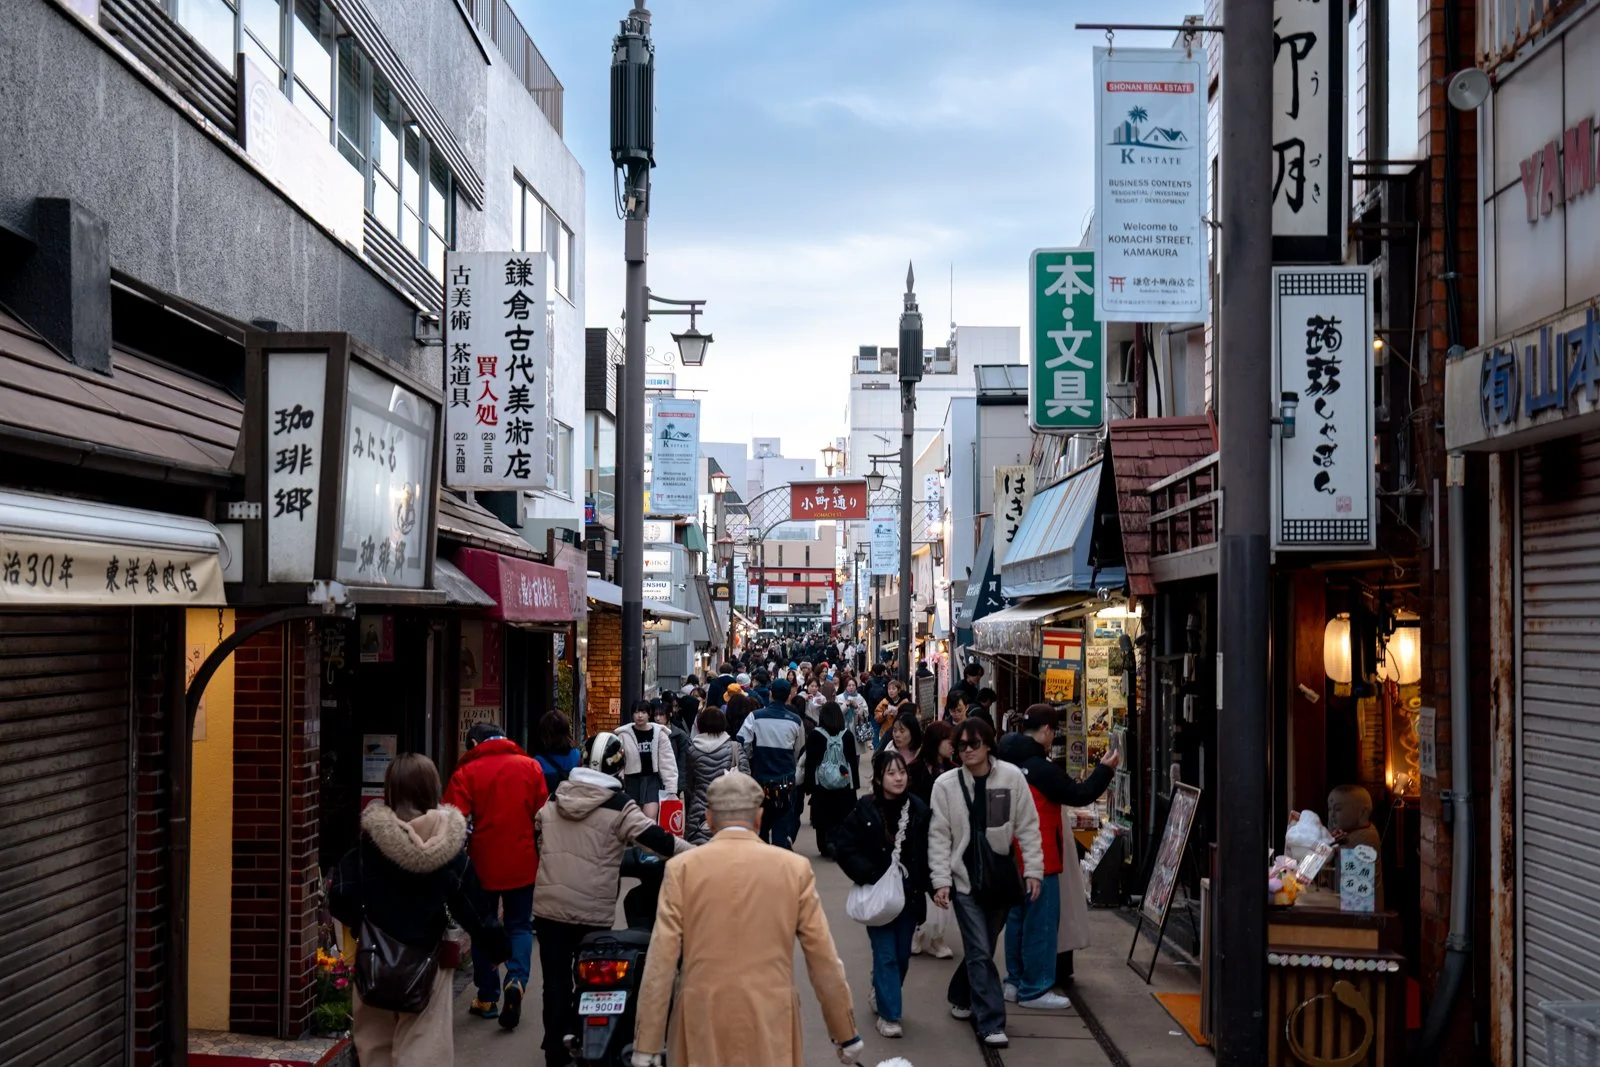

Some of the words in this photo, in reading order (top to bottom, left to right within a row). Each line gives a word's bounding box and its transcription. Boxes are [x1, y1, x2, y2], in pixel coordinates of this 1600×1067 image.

[1109, 83, 1141, 91] SHONAN
[1164, 84, 1191, 92] ESTATE
[1121, 148, 1135, 164] K
[1140, 157, 1181, 165] ESTATE
[1519, 115, 1600, 224] YAM
[1108, 179, 1149, 187] BUSINESS
[1151, 180, 1192, 188] CONTENTS
[1108, 235, 1153, 244] KOMACHI
[1155, 236, 1193, 246] STREET,
[1123, 222, 1167, 231] Welcome
[1169, 222, 1178, 231] to
[1123, 248, 1178, 257] KAMAKURA
[450, 264, 472, 331] 古美術
[1044, 254, 1095, 419] 本・文具
[450, 342, 472, 409] 茶道具
[503, 256, 536, 480] 鎌倉古代美術店
[475, 355, 499, 427] 買入処
[273, 403, 315, 523] 珈琲郷
[801, 494, 857, 511] 小町通り
[105, 554, 199, 595] 東洋食肉店
